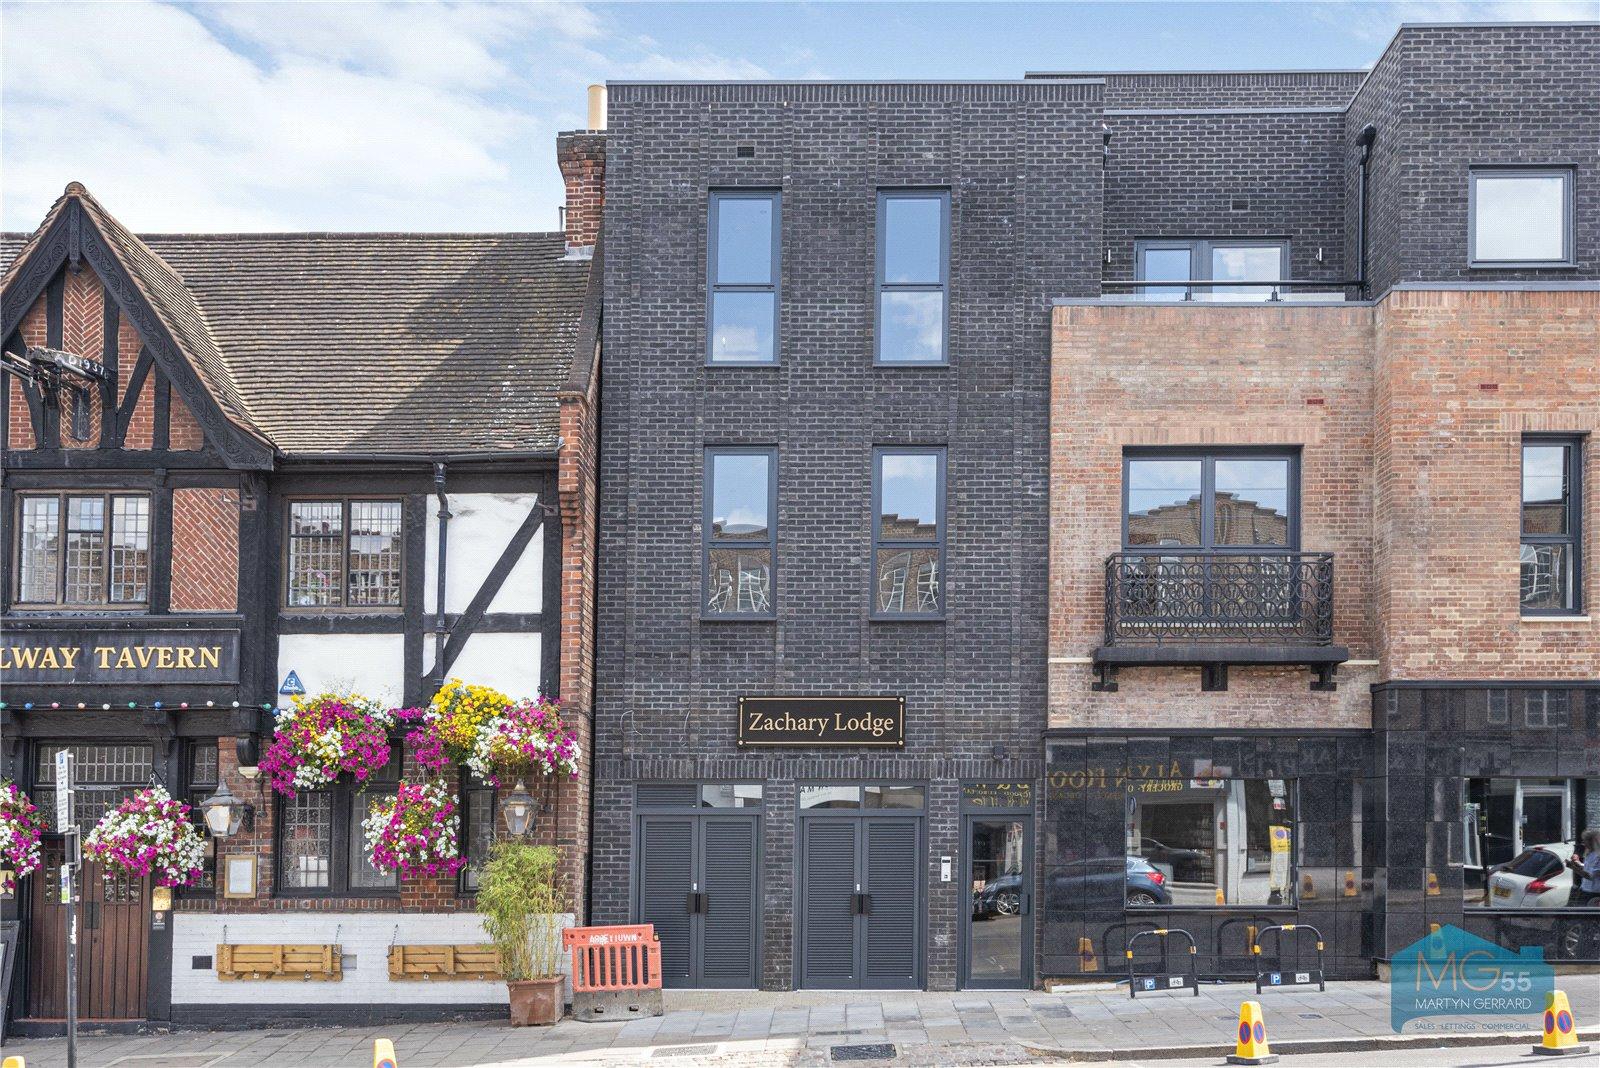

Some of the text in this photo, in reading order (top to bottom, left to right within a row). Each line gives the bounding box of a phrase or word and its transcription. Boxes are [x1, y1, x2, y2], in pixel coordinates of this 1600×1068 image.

[94, 646, 222, 669] TAVERN
[749, 712, 894, 737] Zachary Lodge
